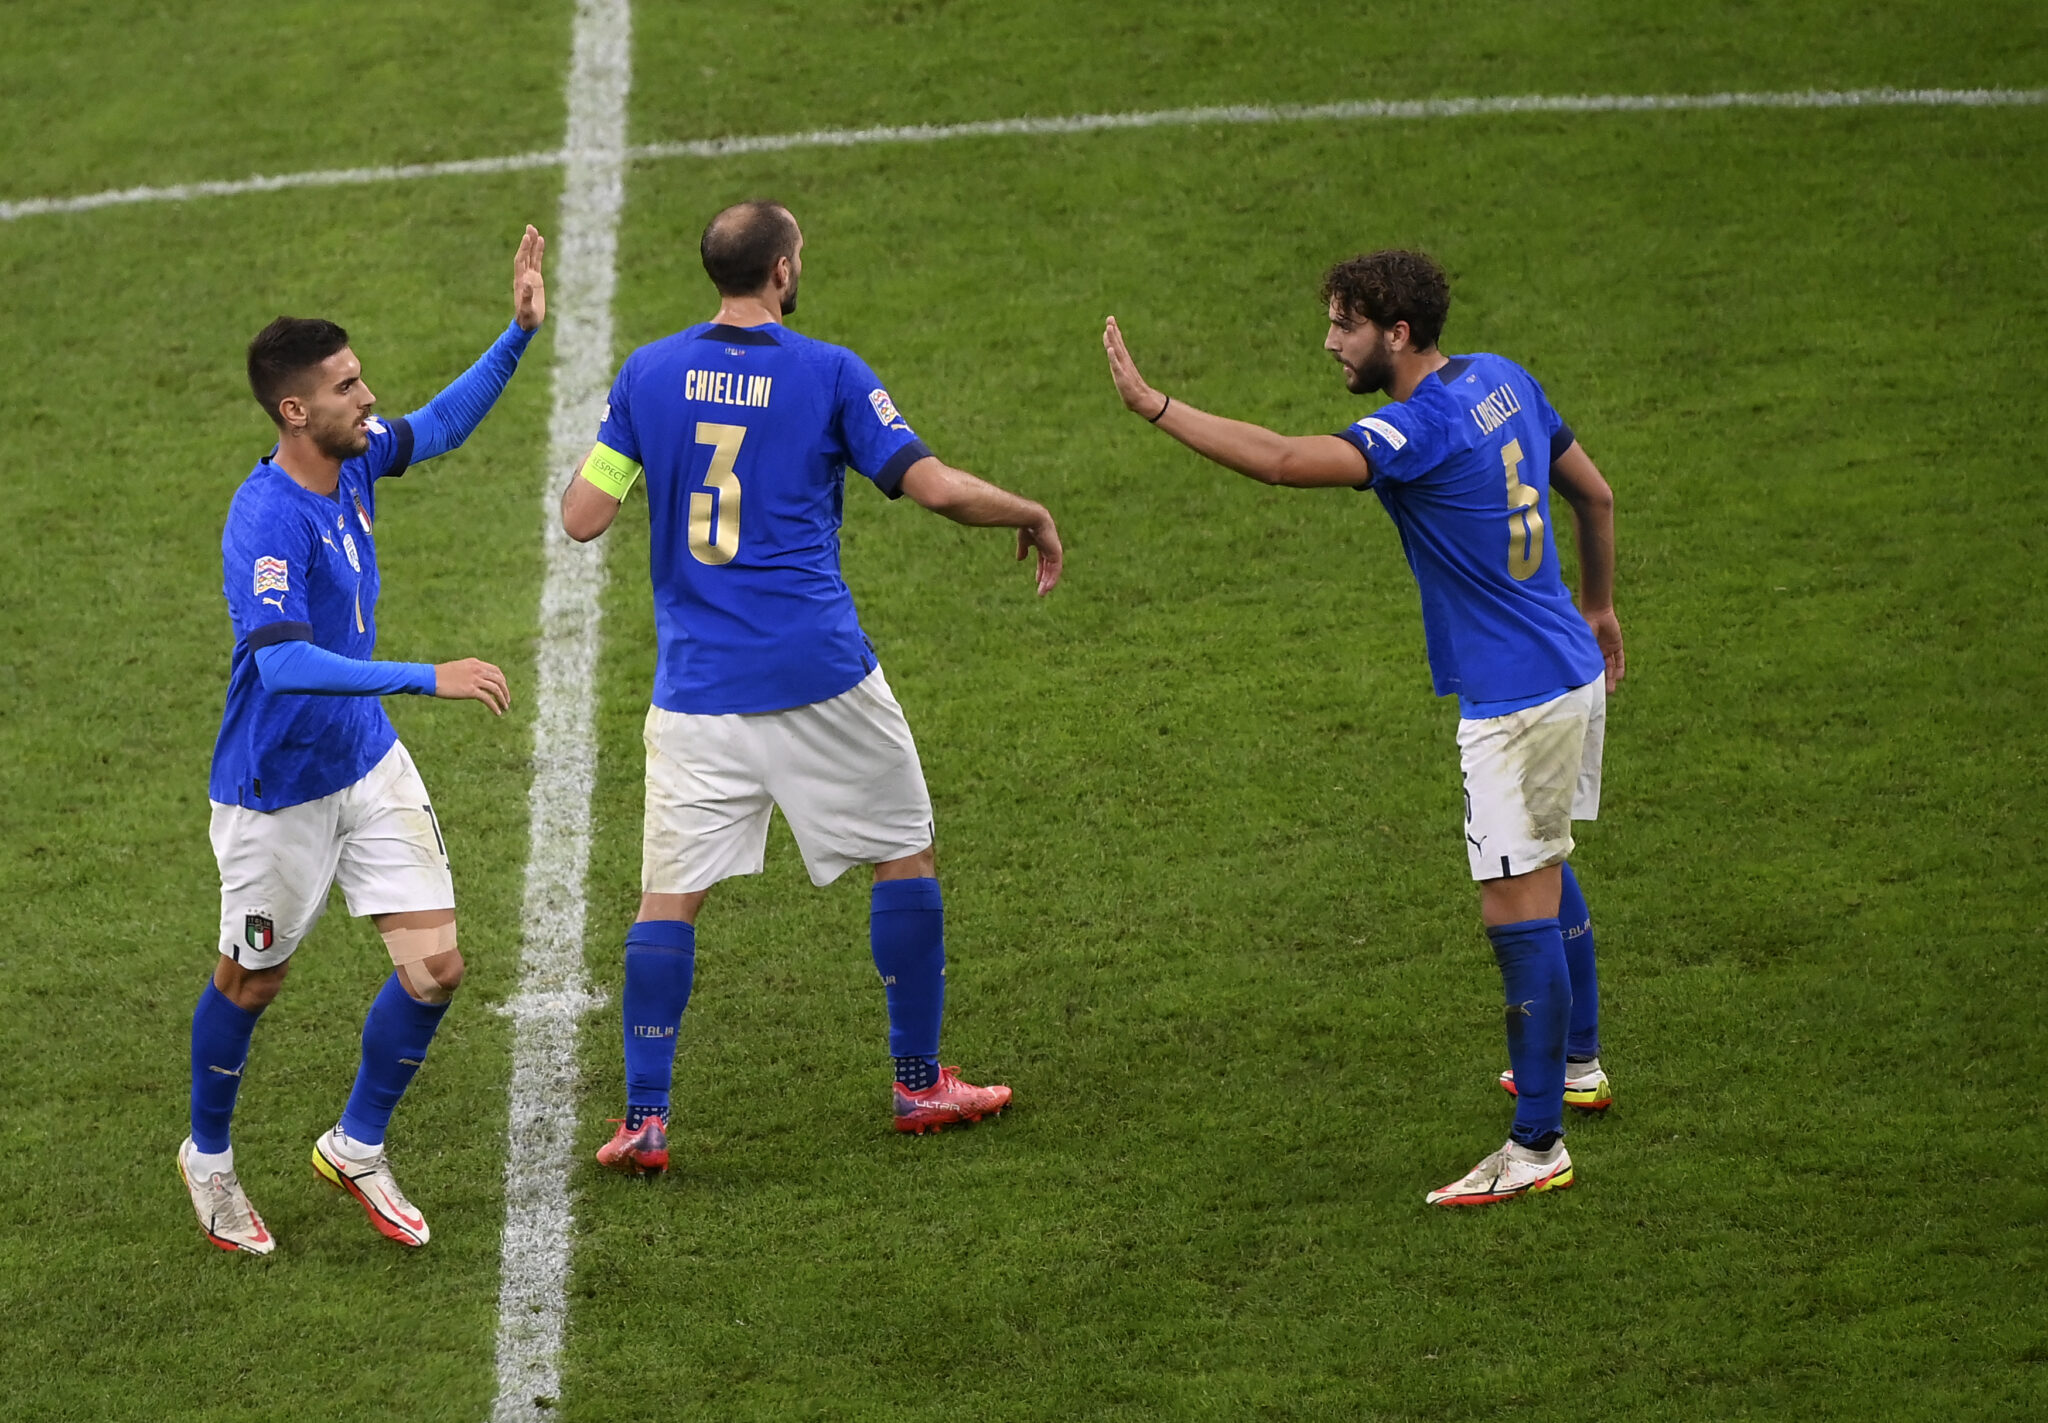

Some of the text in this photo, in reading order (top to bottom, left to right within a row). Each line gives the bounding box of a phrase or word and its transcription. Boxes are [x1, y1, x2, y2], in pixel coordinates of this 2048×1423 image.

[685, 369, 772, 408] CHIELLINI
[688, 422, 747, 565] 3
[634, 1025, 674, 1037] ITALIA
[915, 1099, 960, 1112] ULTRA
